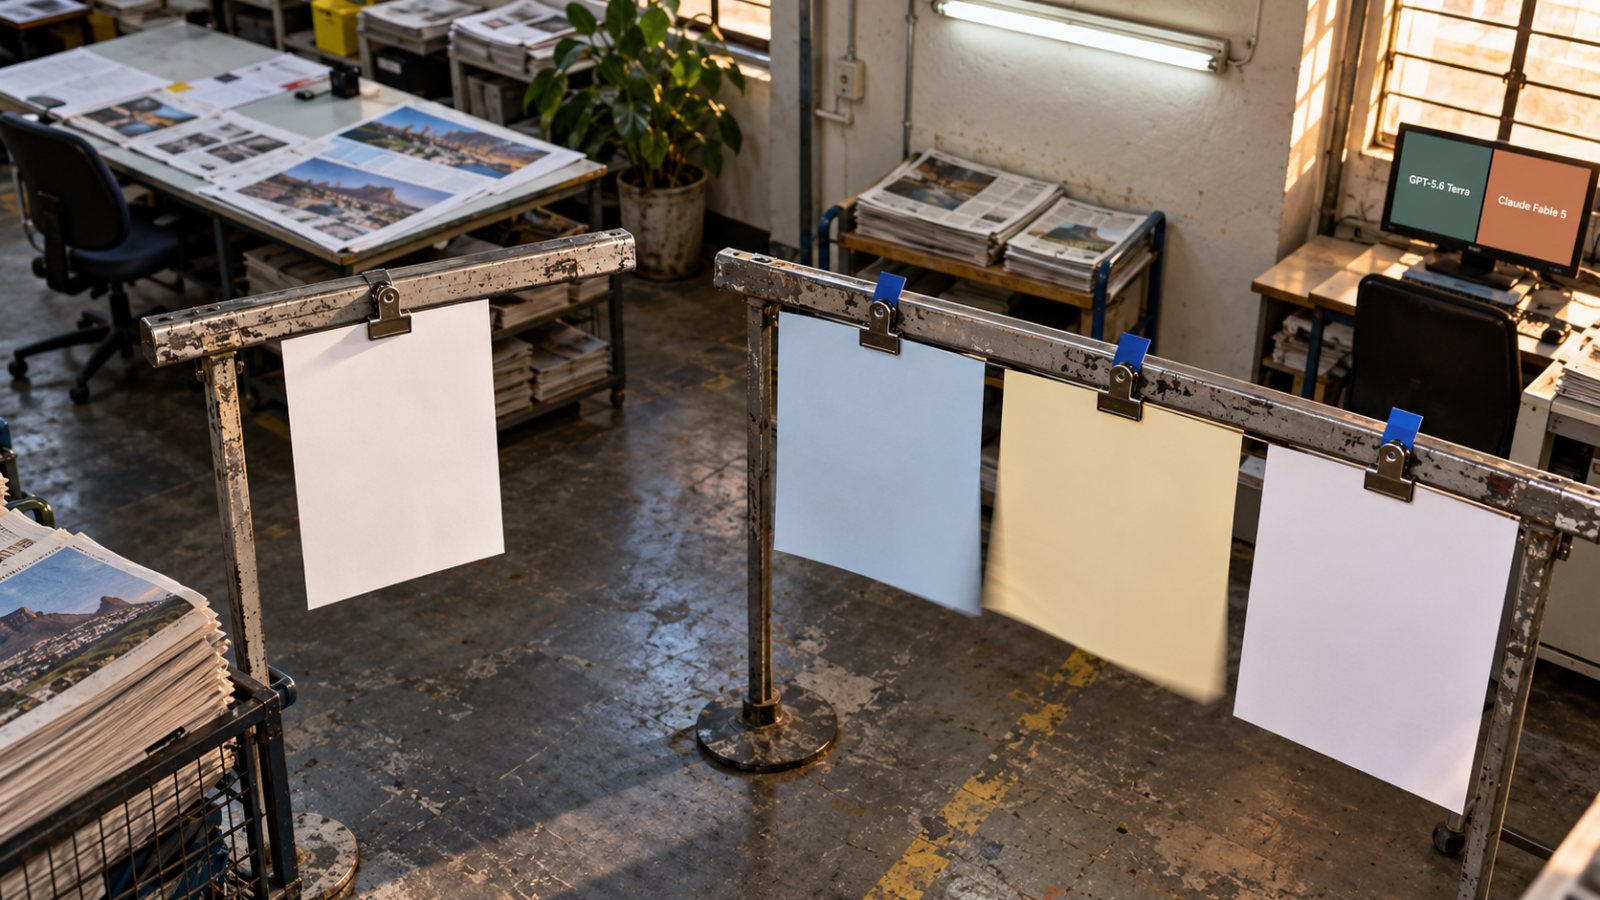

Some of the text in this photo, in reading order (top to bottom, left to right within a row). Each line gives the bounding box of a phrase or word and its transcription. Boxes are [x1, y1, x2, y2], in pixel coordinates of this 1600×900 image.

[1409, 175, 1471, 196] GPT-5.6 Terra
[1498, 196, 1567, 219] Claude Fable 5
